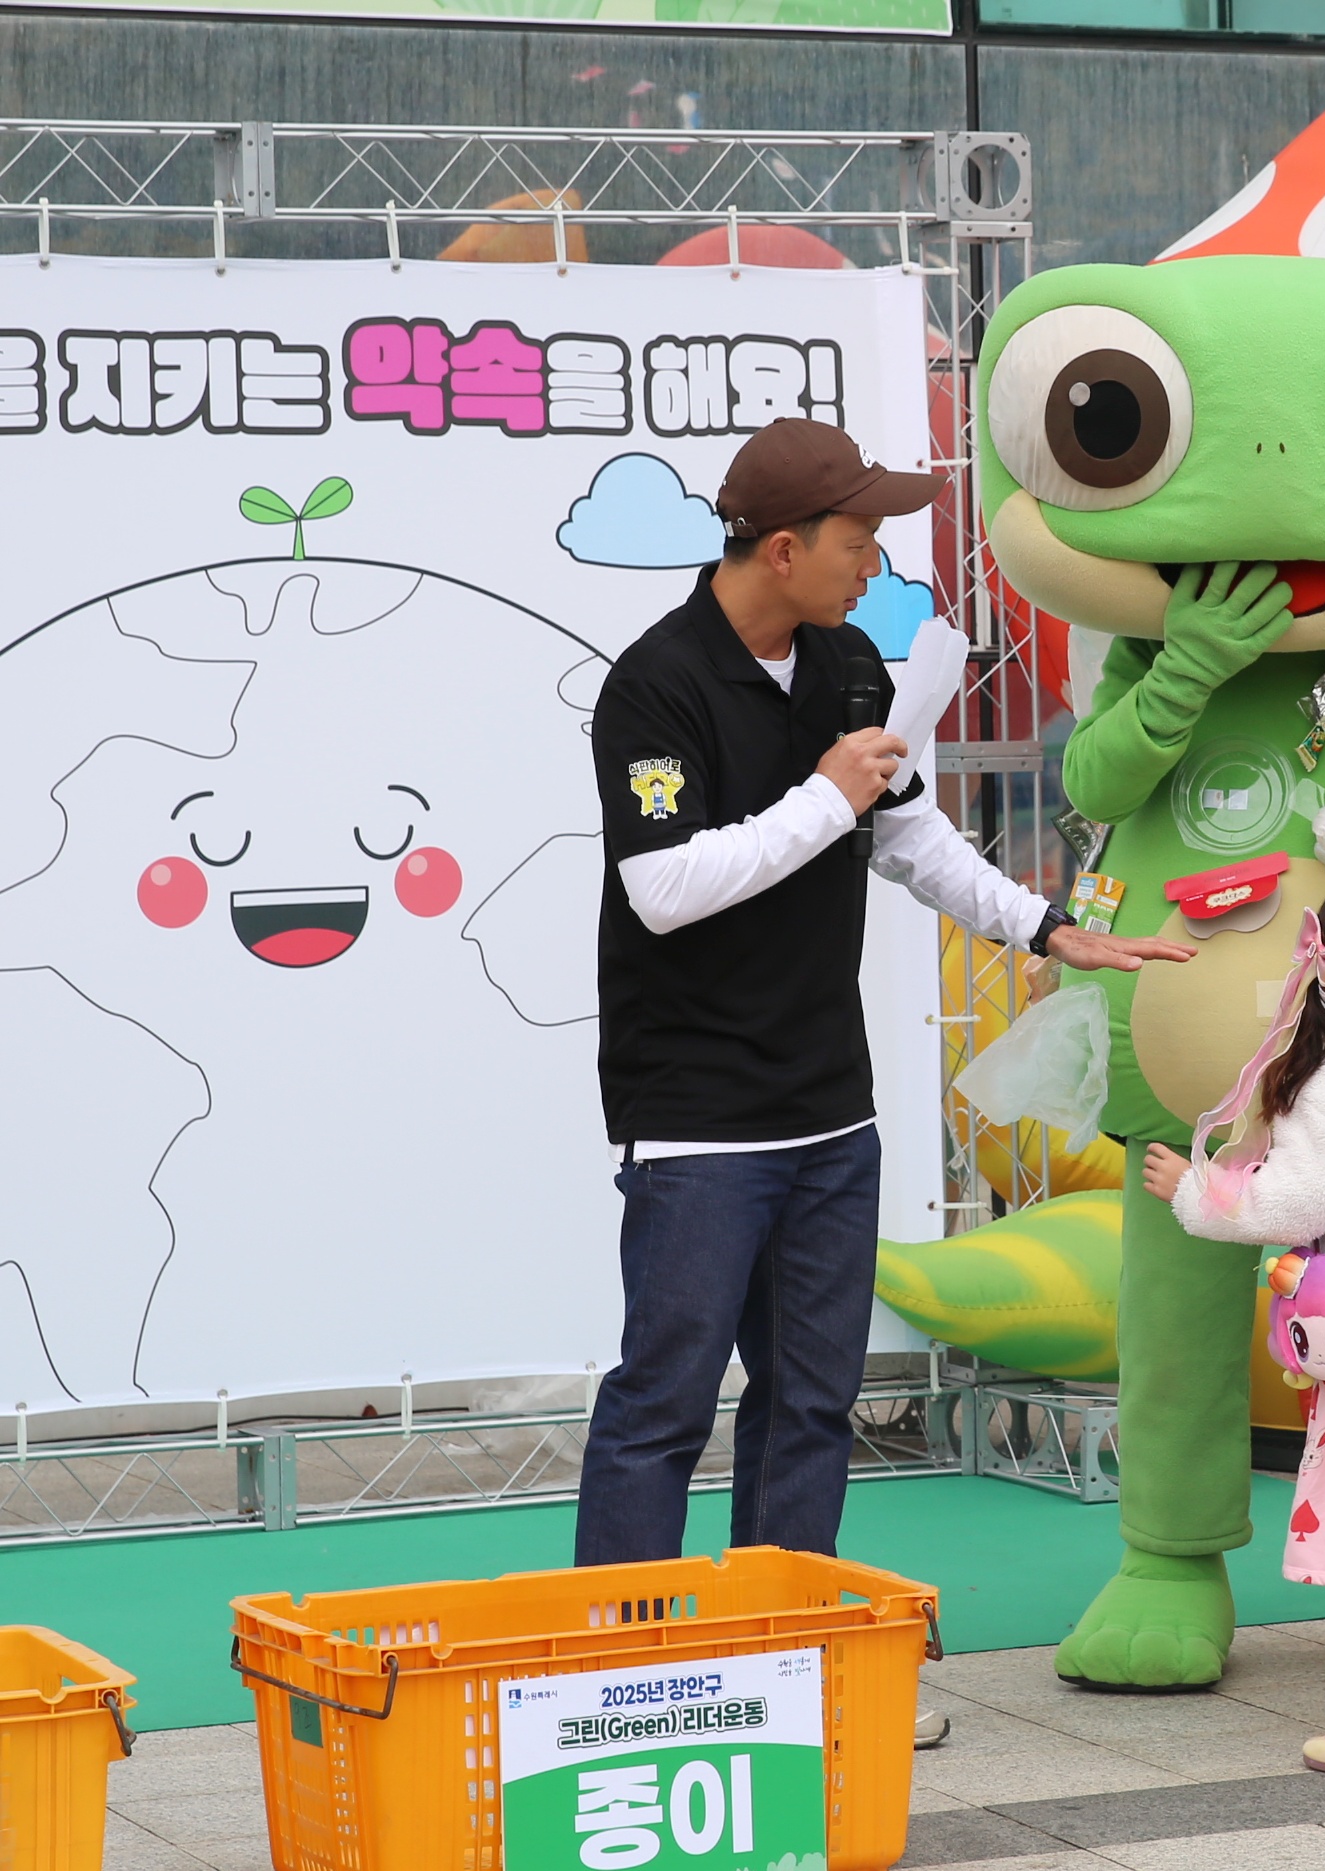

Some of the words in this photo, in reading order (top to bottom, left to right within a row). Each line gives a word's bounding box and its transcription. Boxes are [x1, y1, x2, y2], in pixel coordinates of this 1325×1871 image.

[57, 328, 330, 436] 지키는
[342, 316, 633, 438] 약속을
[643, 333, 845, 438] 해요!
[629, 757, 681, 775] 식판히어로
[600, 1680, 665, 1708] 2025년
[667, 1674, 723, 1701] 장안구
[558, 1705, 681, 1749] 그린(Green)
[680, 1697, 767, 1734] 리더운동
[574, 1753, 754, 1870] 종이
